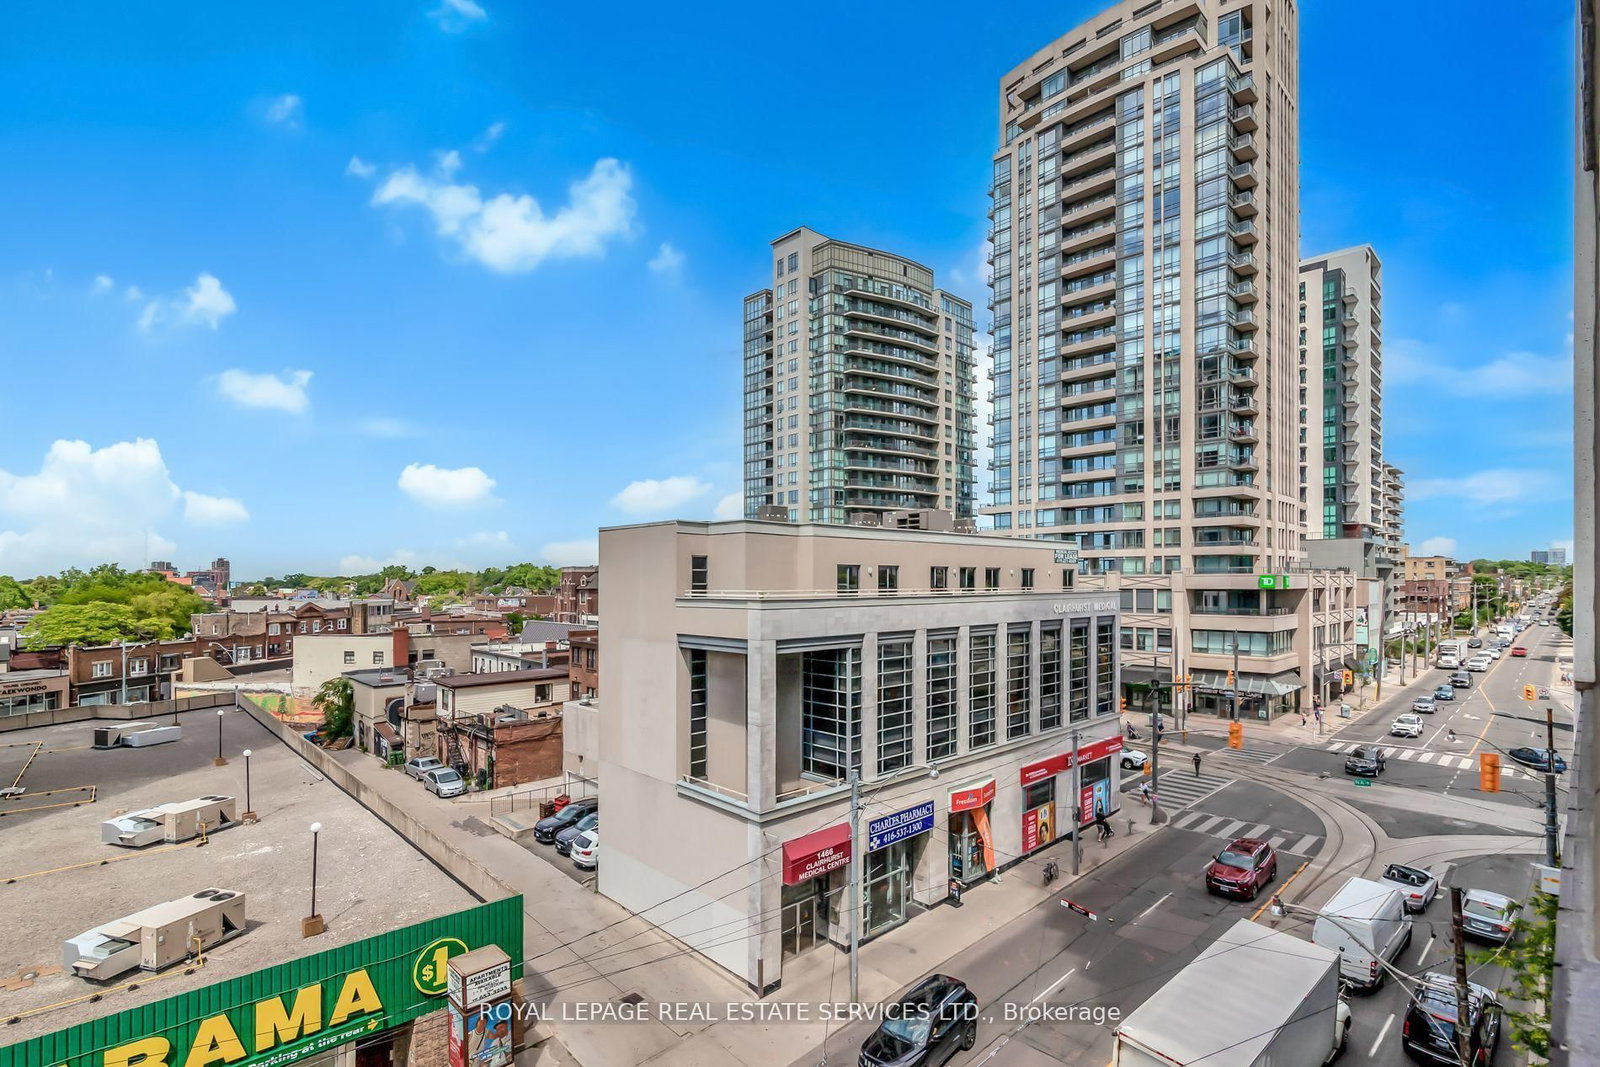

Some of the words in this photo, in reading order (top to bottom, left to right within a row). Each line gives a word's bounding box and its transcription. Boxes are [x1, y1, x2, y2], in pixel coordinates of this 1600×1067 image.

[1261, 577, 1274, 586] TD
[870, 815, 900, 834] CHARLES
[900, 803, 933, 824] PHARMACY
[883, 821, 923, 844] 416-537-1300
[806, 852, 844, 871] CLAIRHURST
[817, 848, 834, 860] 1466
[799, 866, 827, 880] MEDICAL
[827, 856, 850, 870] CENTRE
[469, 965, 508, 983] APARTMENTS
